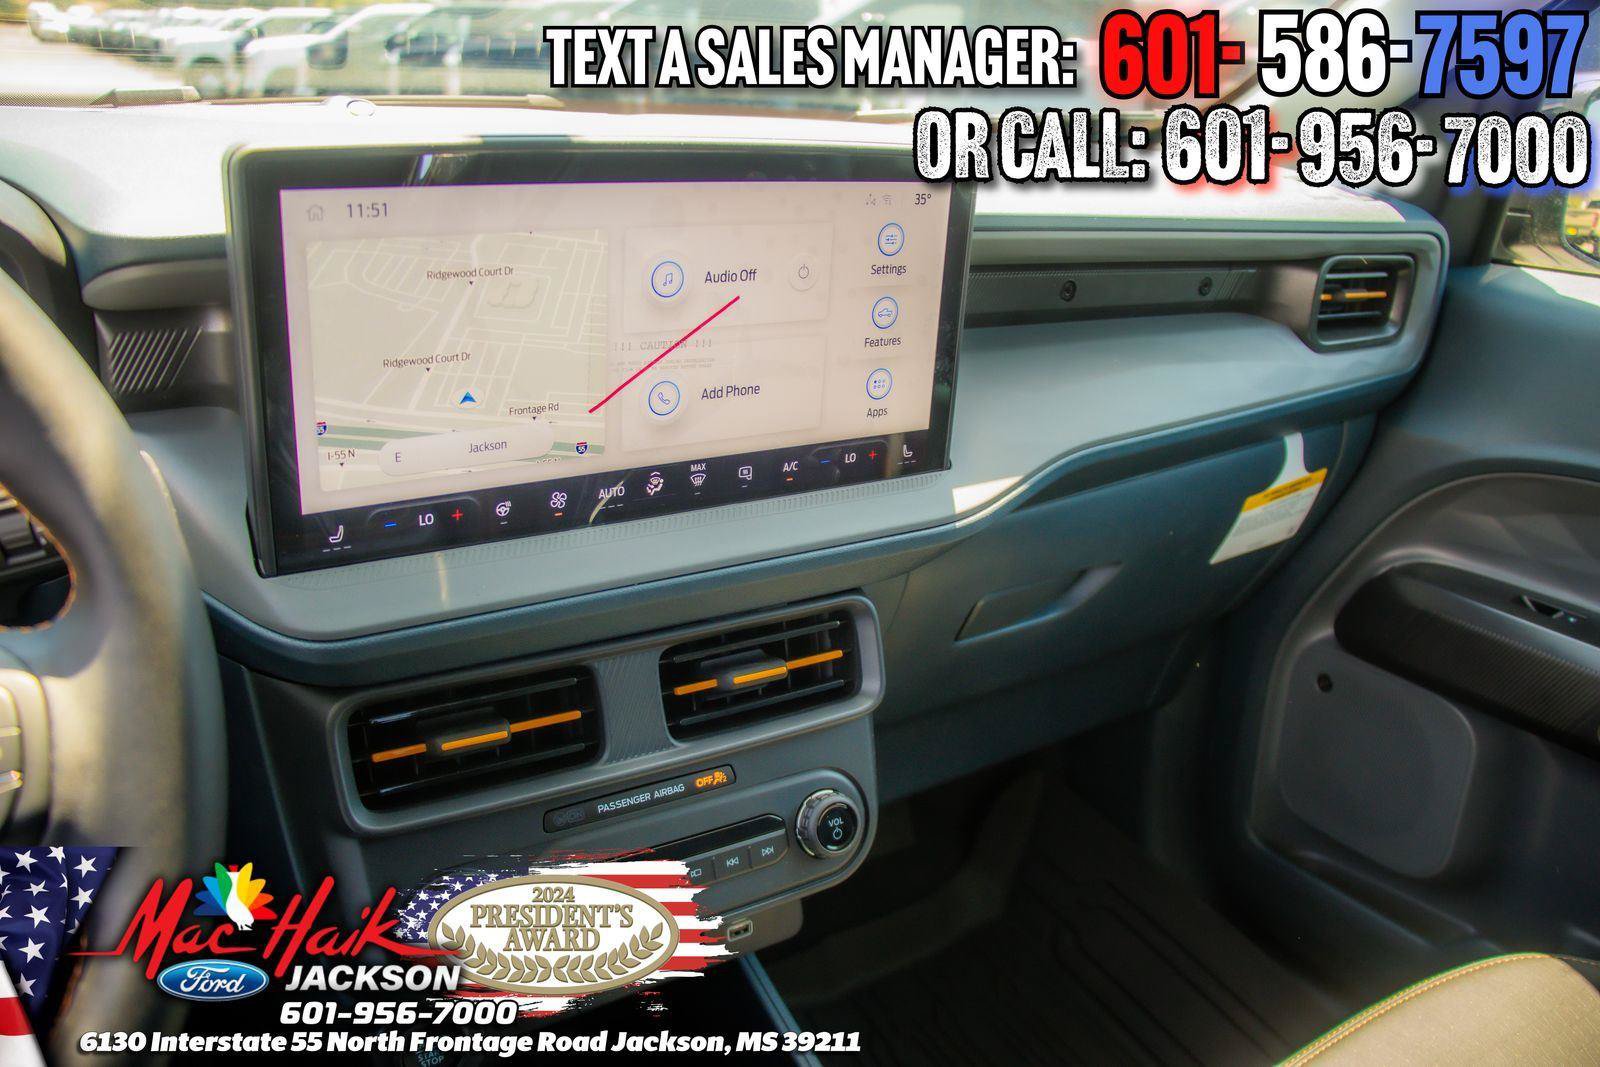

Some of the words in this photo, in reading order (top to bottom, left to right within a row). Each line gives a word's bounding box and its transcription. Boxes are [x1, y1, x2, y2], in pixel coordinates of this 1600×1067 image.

[347, 202, 389, 218] 11:51
[426, 267, 477, 281] Ridgewood
[478, 267, 502, 277] Court
[504, 265, 514, 275] Dr
[704, 270, 738, 283] Audio
[740, 268, 757, 282] Off
[871, 264, 907, 276] Settings
[864, 337, 901, 347] Features
[382, 355, 434, 369] Ridgewood
[435, 354, 458, 365] Court
[460, 352, 471, 362] Dr
[701, 387, 723, 400] Add
[725, 384, 760, 398] Phone
[508, 403, 547, 416] Frontage
[548, 402, 560, 412] Rd
[866, 407, 888, 418] Apps
[468, 440, 508, 453] Jackson
[327, 450, 347, 461] I-55
[348, 449, 355, 459] N
[845, 452, 857, 464] LO
[690, 462, 706, 472] MAX
[783, 461, 799, 473] A/C
[598, 486, 626, 499] AUTO
[418, 513, 434, 526] LO
[695, 775, 713, 788] OFF
[597, 793, 651, 814] PASSENGER
[653, 783, 685, 800] AIRBAG
[828, 817, 844, 827] VOL
